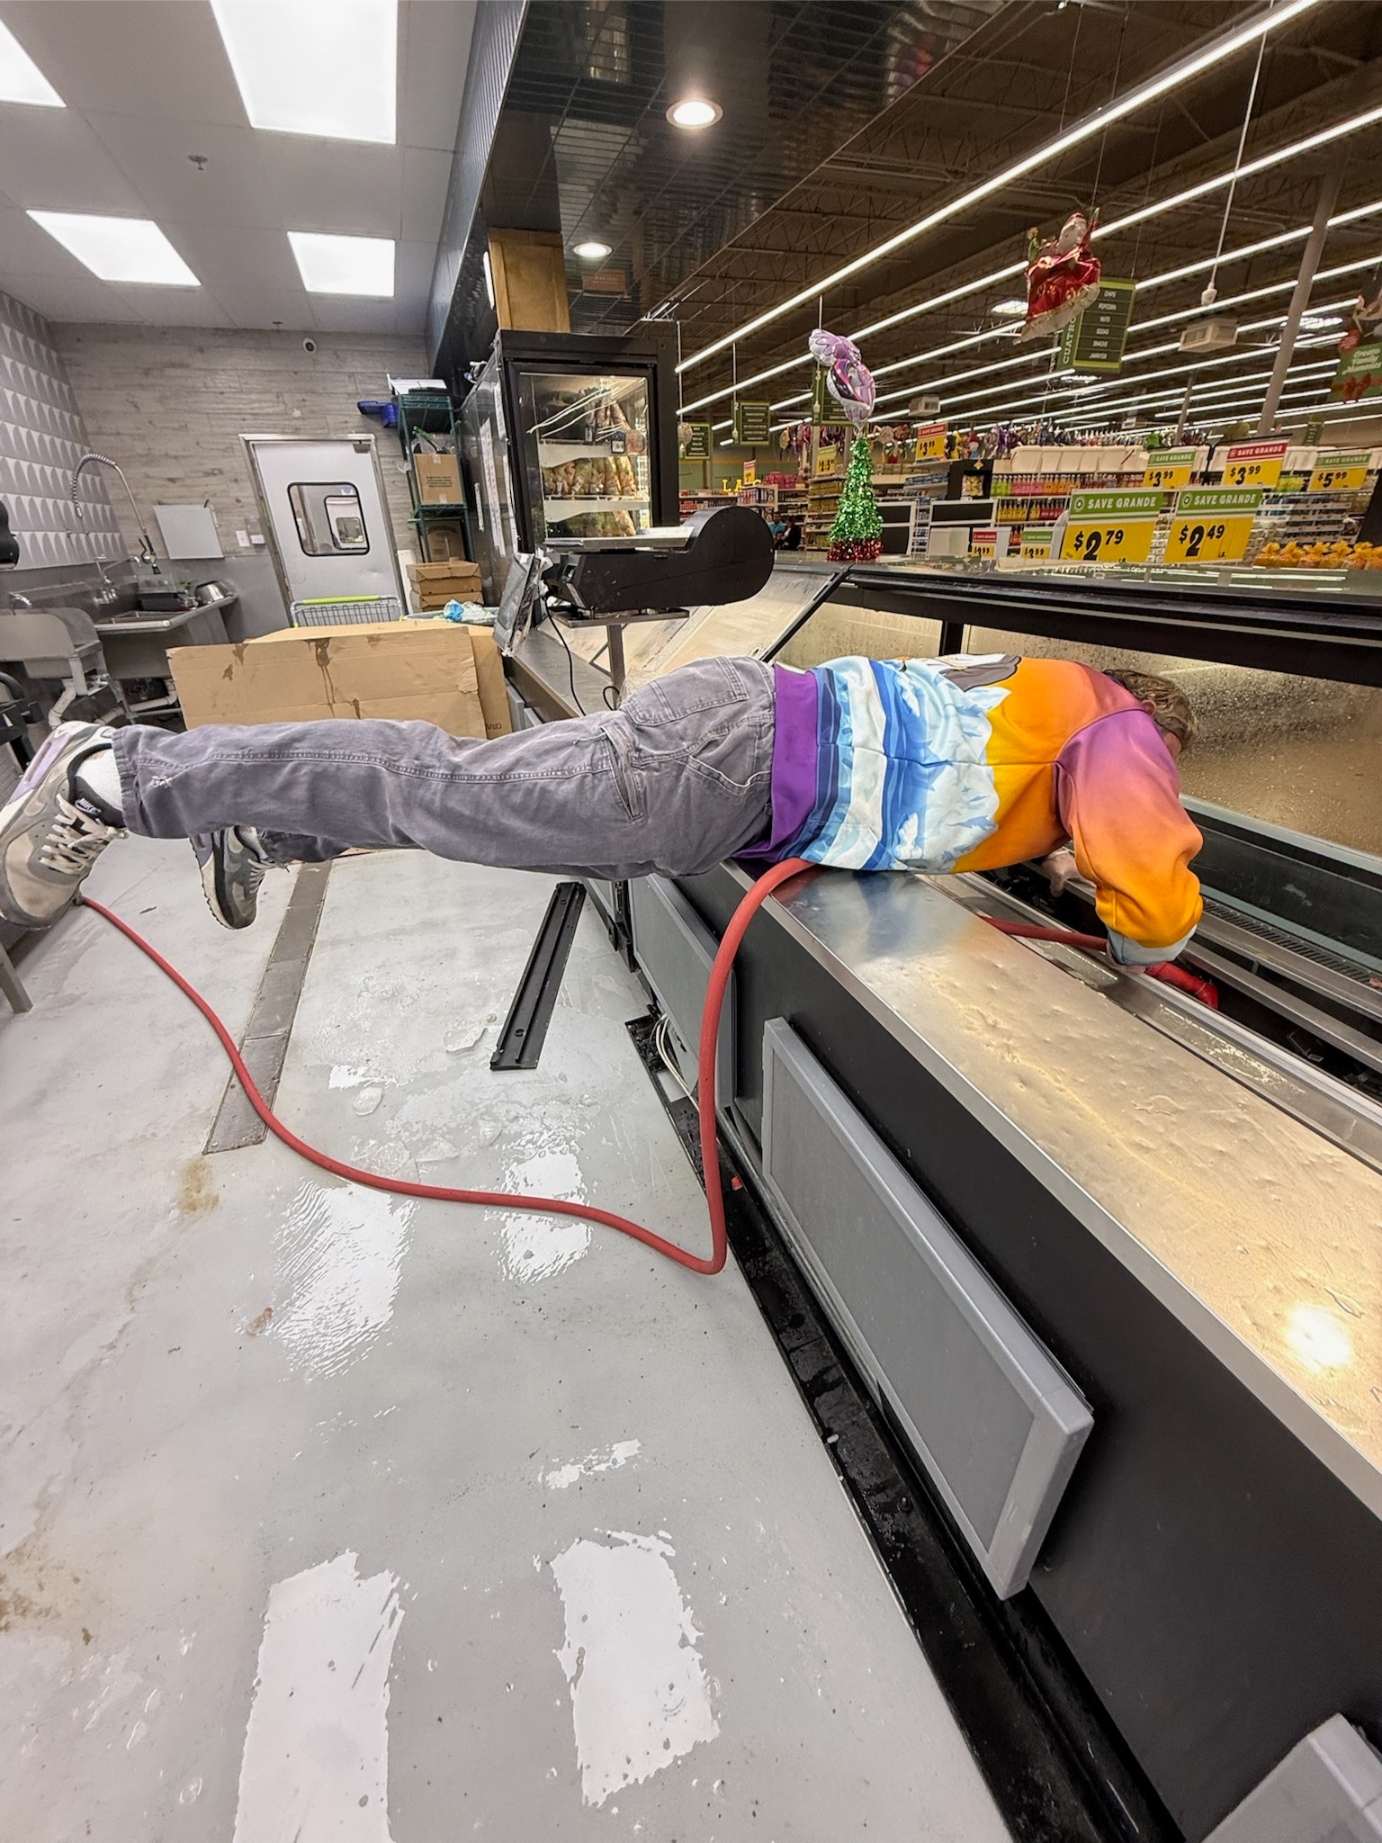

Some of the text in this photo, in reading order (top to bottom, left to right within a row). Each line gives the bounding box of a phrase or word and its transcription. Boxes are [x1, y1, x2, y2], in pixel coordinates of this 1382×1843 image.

[1062, 316, 1077, 364] CUATRO
[1236, 445, 1283, 456] SAVE GRANDE
[1087, 496, 1157, 509] SAVE GRANDE
[1194, 493, 1256, 506] SAVE GRANDE
